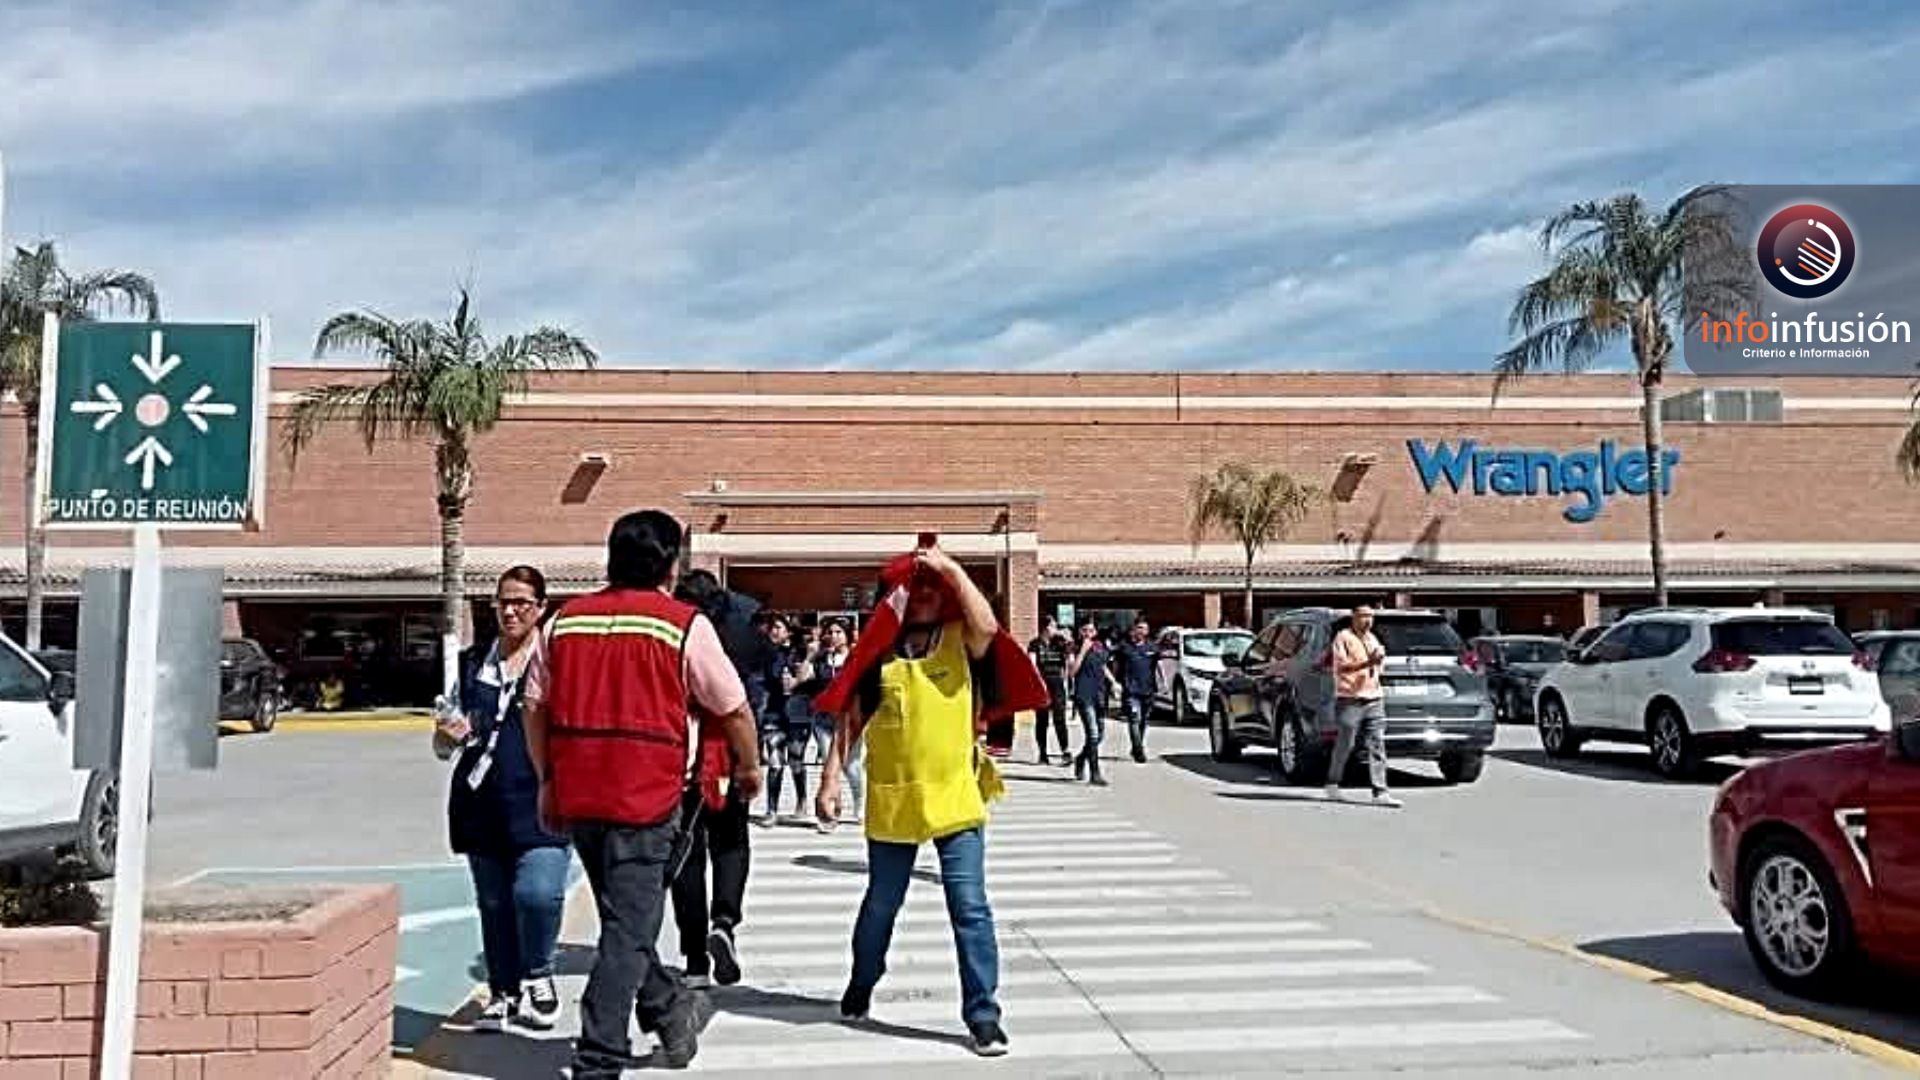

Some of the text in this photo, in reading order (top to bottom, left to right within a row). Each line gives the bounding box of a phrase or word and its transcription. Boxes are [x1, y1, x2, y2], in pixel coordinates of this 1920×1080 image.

[48, 495, 248, 519] PUNTO DE REUNIÓN
[1406, 438, 1680, 523] Wrangler
